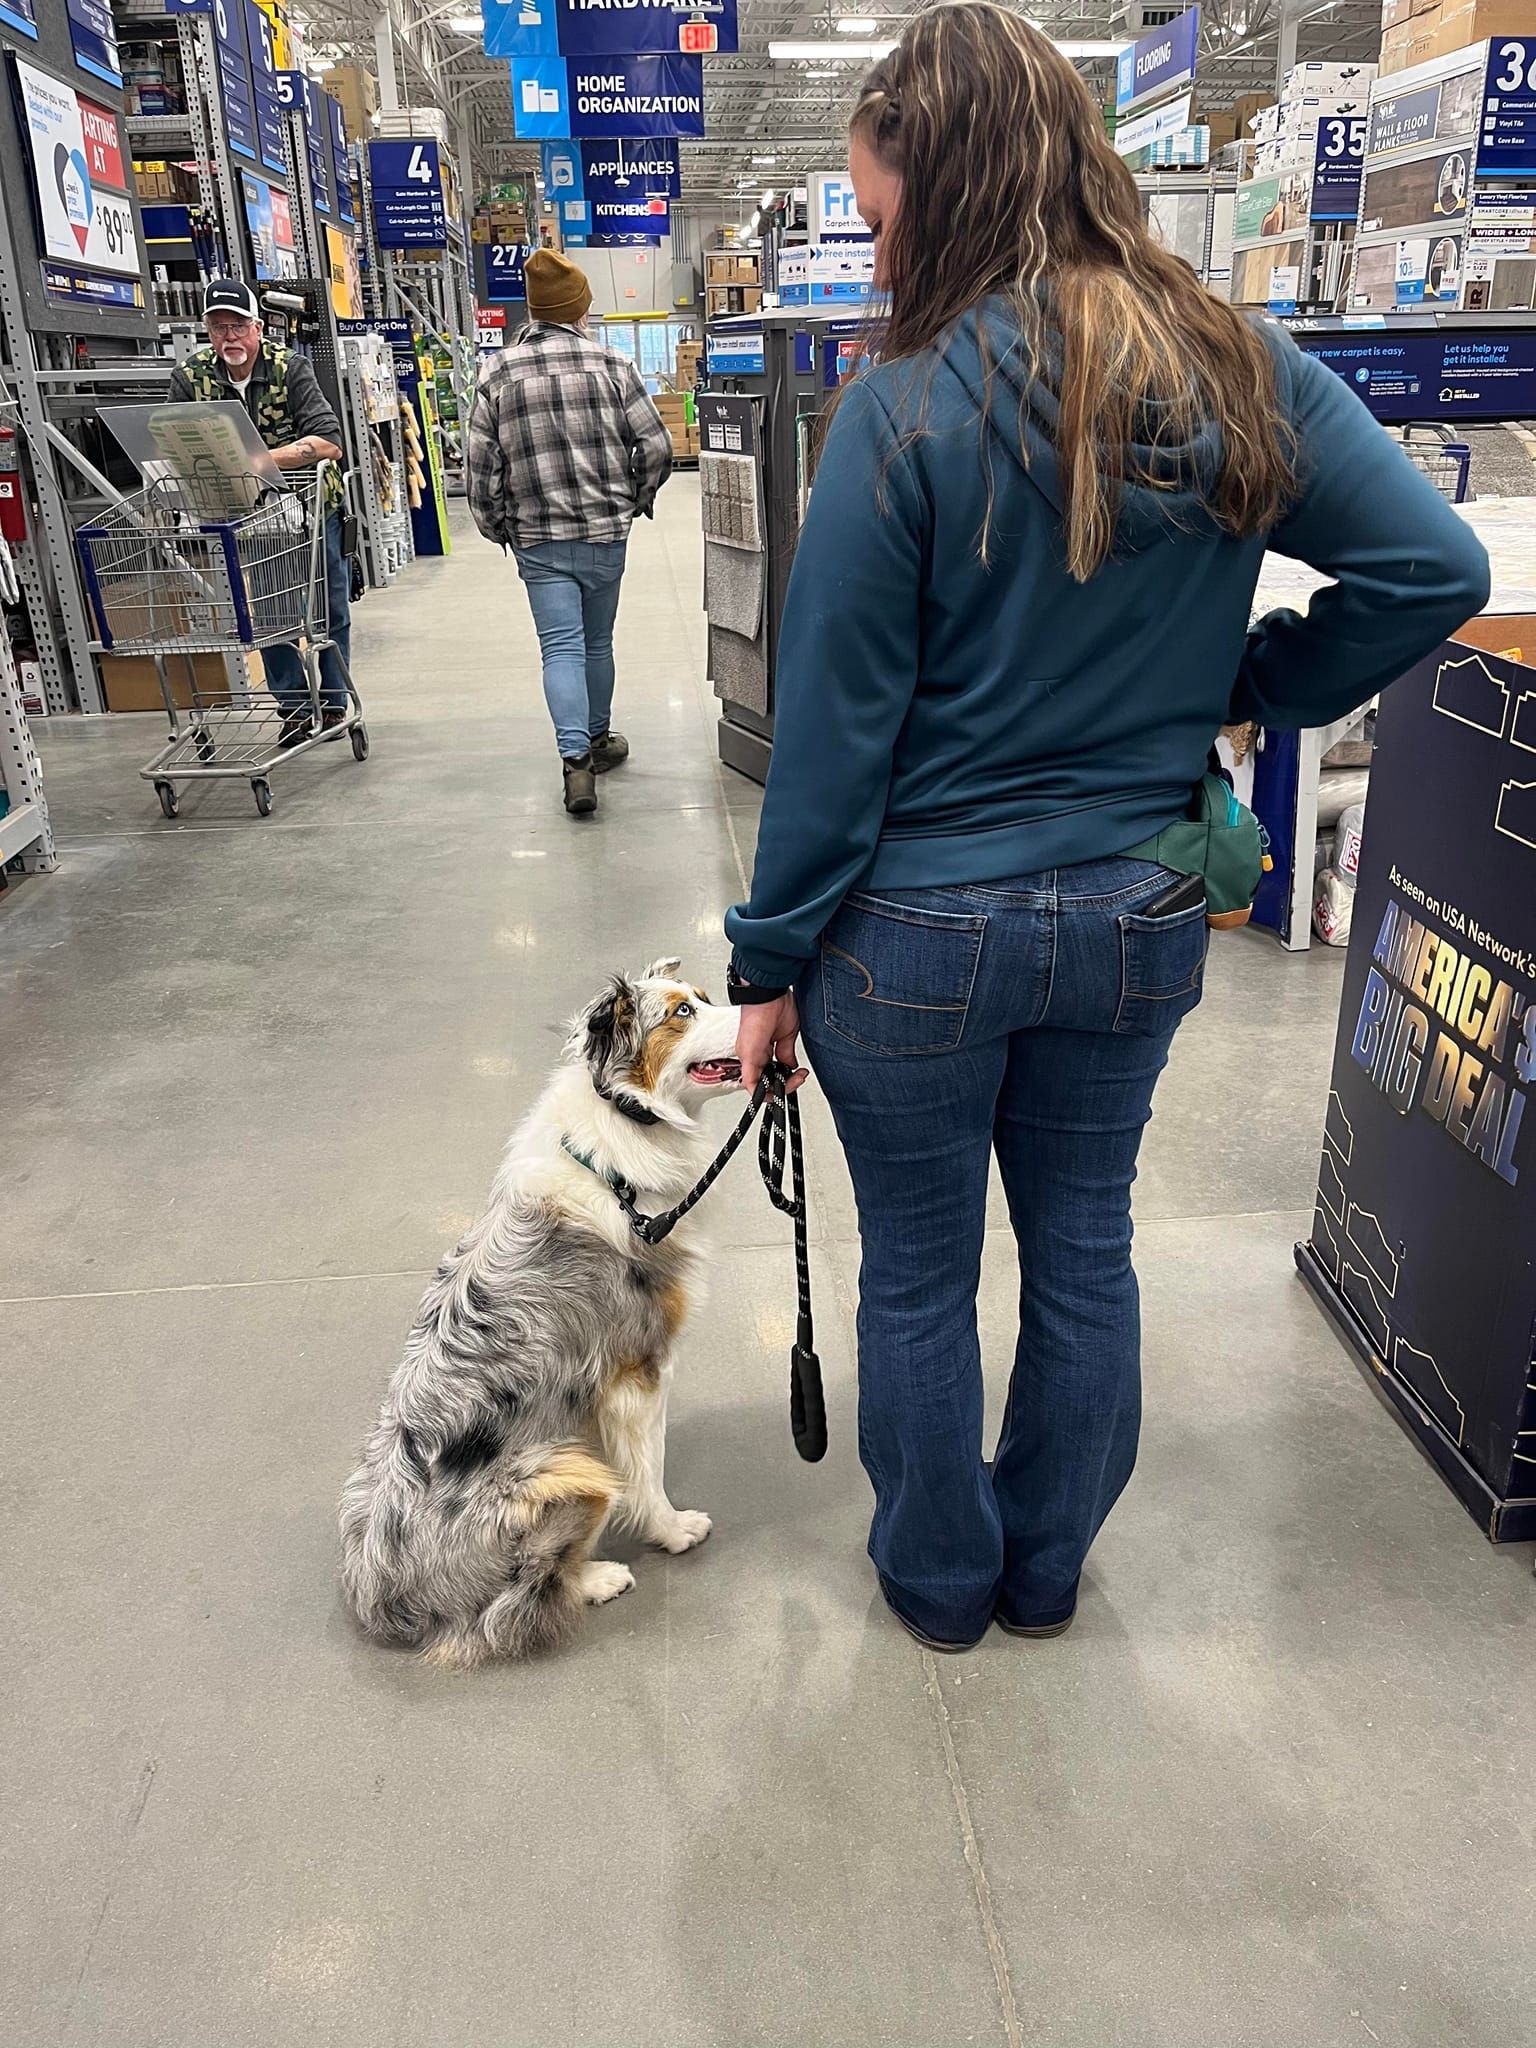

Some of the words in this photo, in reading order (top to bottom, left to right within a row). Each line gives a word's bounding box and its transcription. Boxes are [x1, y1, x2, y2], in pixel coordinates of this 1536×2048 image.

[259, 12, 272, 72] 5
[685, 26, 711, 49] EXIT
[1136, 41, 1171, 78] FLOORING
[276, 76, 293, 103] 5
[577, 76, 625, 92] HOME
[578, 96, 700, 113] ORGANIZATION
[82, 110, 118, 149] ARTING
[1376, 124, 1394, 139] WALL
[1396, 122, 1402, 133] &
[1404, 114, 1429, 132] FLOOR
[1499, 120, 1513, 128] Vinyl
[1325, 121, 1367, 156] 35
[1374, 135, 1400, 152] PLANKS
[93, 145, 106, 173] AT
[408, 145, 433, 183] 4
[589, 161, 674, 176] APPLIANCES
[597, 204, 651, 216] KITCHENS
[824, 183, 856, 216] Fr
[825, 220, 850, 228] Carpet
[491, 245, 518, 266] 27
[824, 249, 843, 258] Free
[339, 322, 354, 332] Buy
[355, 322, 372, 331] One
[374, 321, 390, 330] Get
[390, 321, 408, 330] One
[1282, 317, 1318, 331] Style
[1321, 349, 1341, 357] new
[1342, 347, 1372, 359] carpet
[1373, 347, 1381, 356] is
[1382, 348, 1405, 357] easy.
[1445, 344, 1460, 353] Let
[1472, 344, 1492, 354] help
[1493, 345, 1509, 353] you
[1443, 356, 1458, 366] get
[1459, 355, 1466, 363] it
[1467, 355, 1507, 363] installed.
[1389, 865, 1401, 887] As
[1401, 878, 1425, 906] seen
[1426, 896, 1440, 916] on
[1441, 901, 1466, 935] USA
[1468, 919, 1536, 979] Network's
[1372, 899, 1536, 1084] AMERICA'S
[1351, 966, 1429, 1115] BIG
[1421, 1030, 1526, 1186] DEAL
